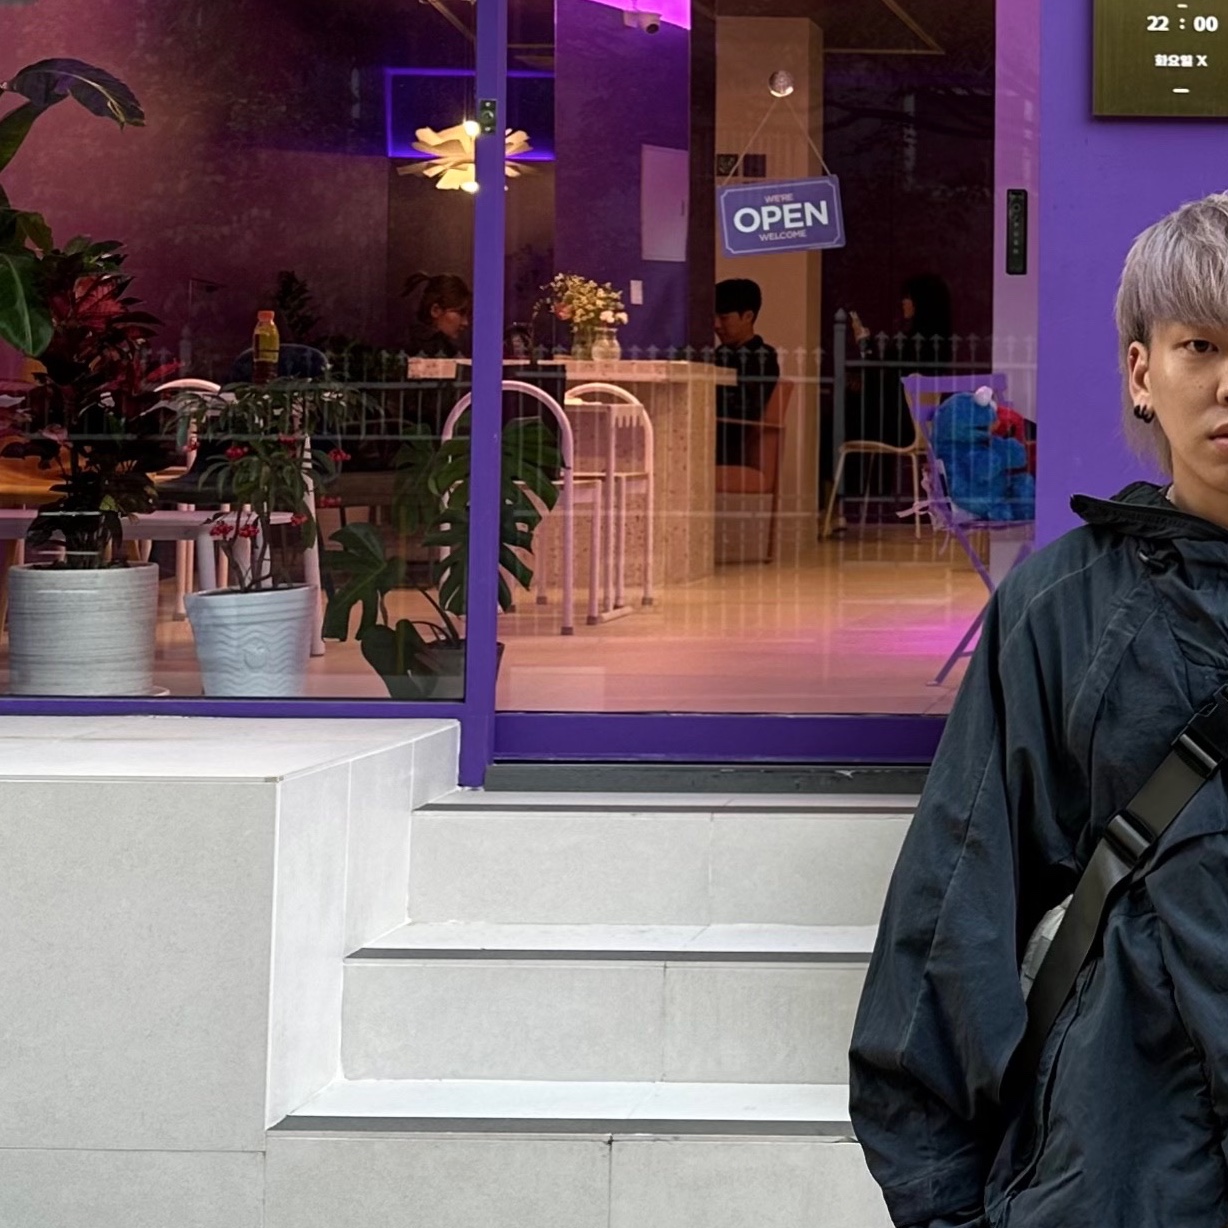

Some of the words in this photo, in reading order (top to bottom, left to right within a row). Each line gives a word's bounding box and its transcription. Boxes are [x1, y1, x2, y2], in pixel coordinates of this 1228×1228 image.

[1147, 15, 1169, 31] 22
[1194, 16, 1218, 32] 00
[734, 200, 828, 232] OPEN
[759, 230, 806, 241] WELCOME
